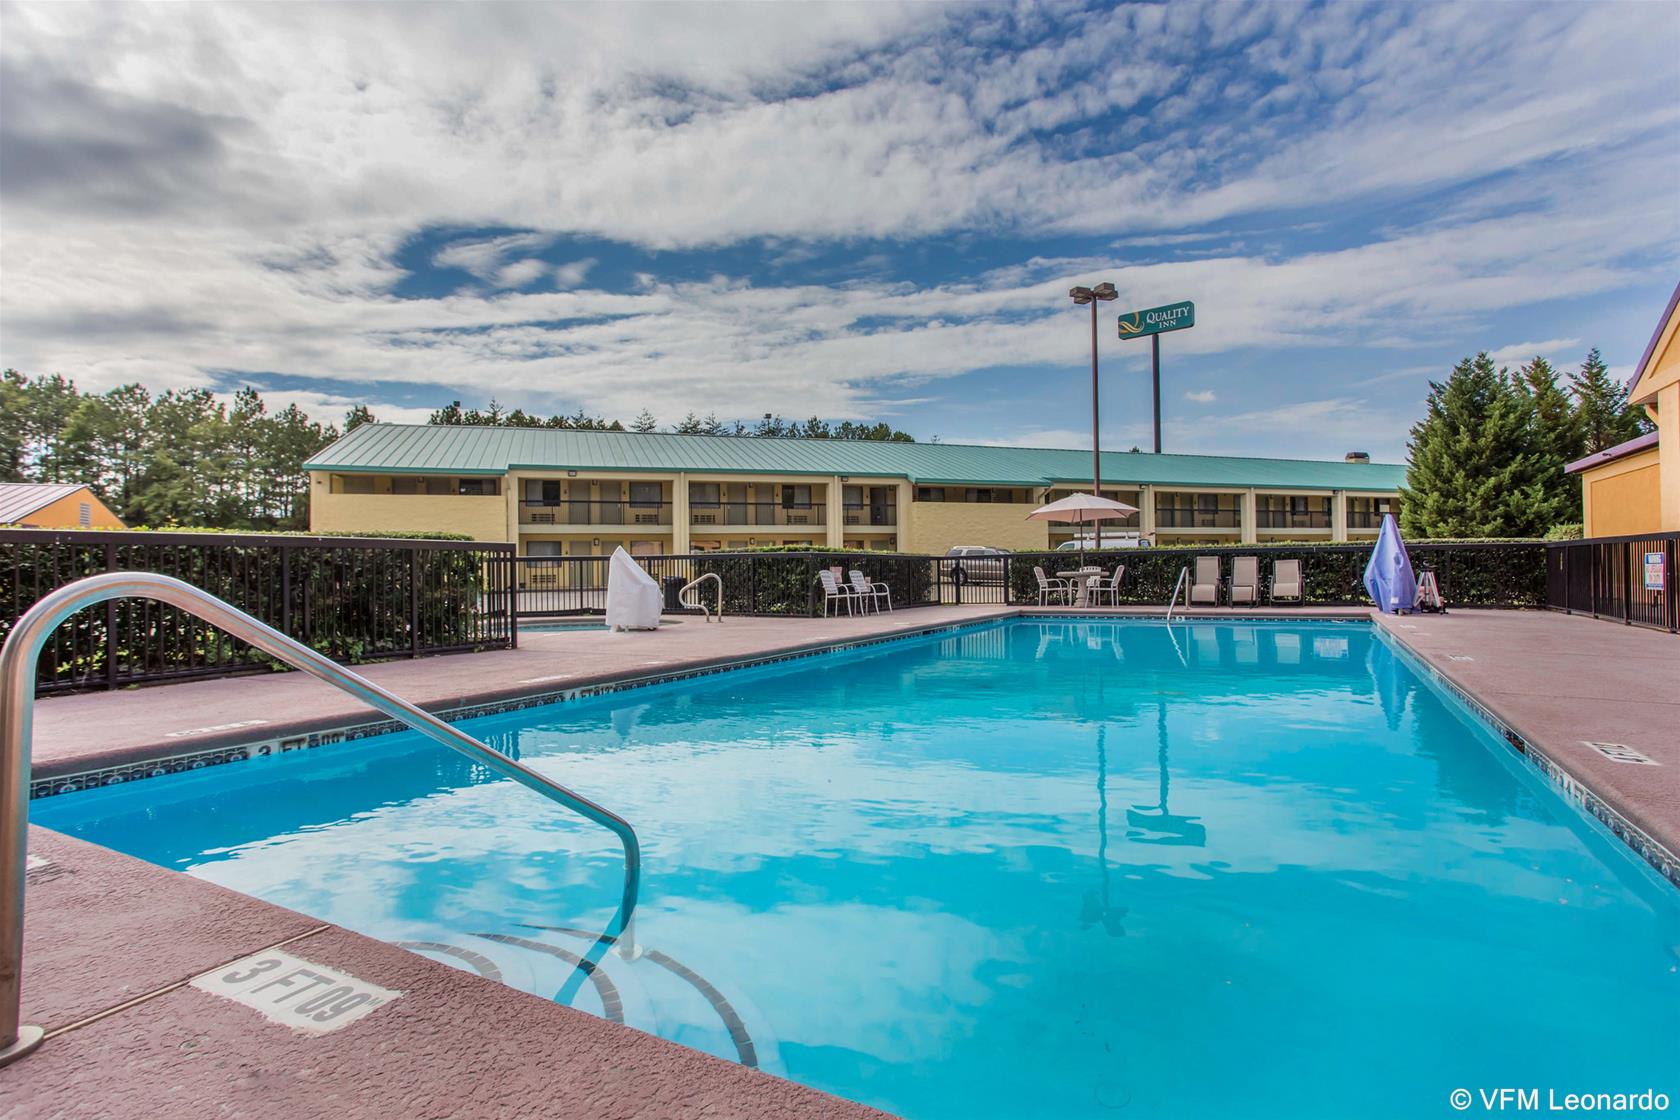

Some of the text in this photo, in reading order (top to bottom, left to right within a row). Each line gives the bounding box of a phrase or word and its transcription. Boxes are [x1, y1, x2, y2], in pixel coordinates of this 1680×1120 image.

[1146, 306, 1190, 324] QUALITY
[1159, 319, 1177, 329] INN
[221, 958, 283, 984] 3
[249, 968, 337, 1004] FT
